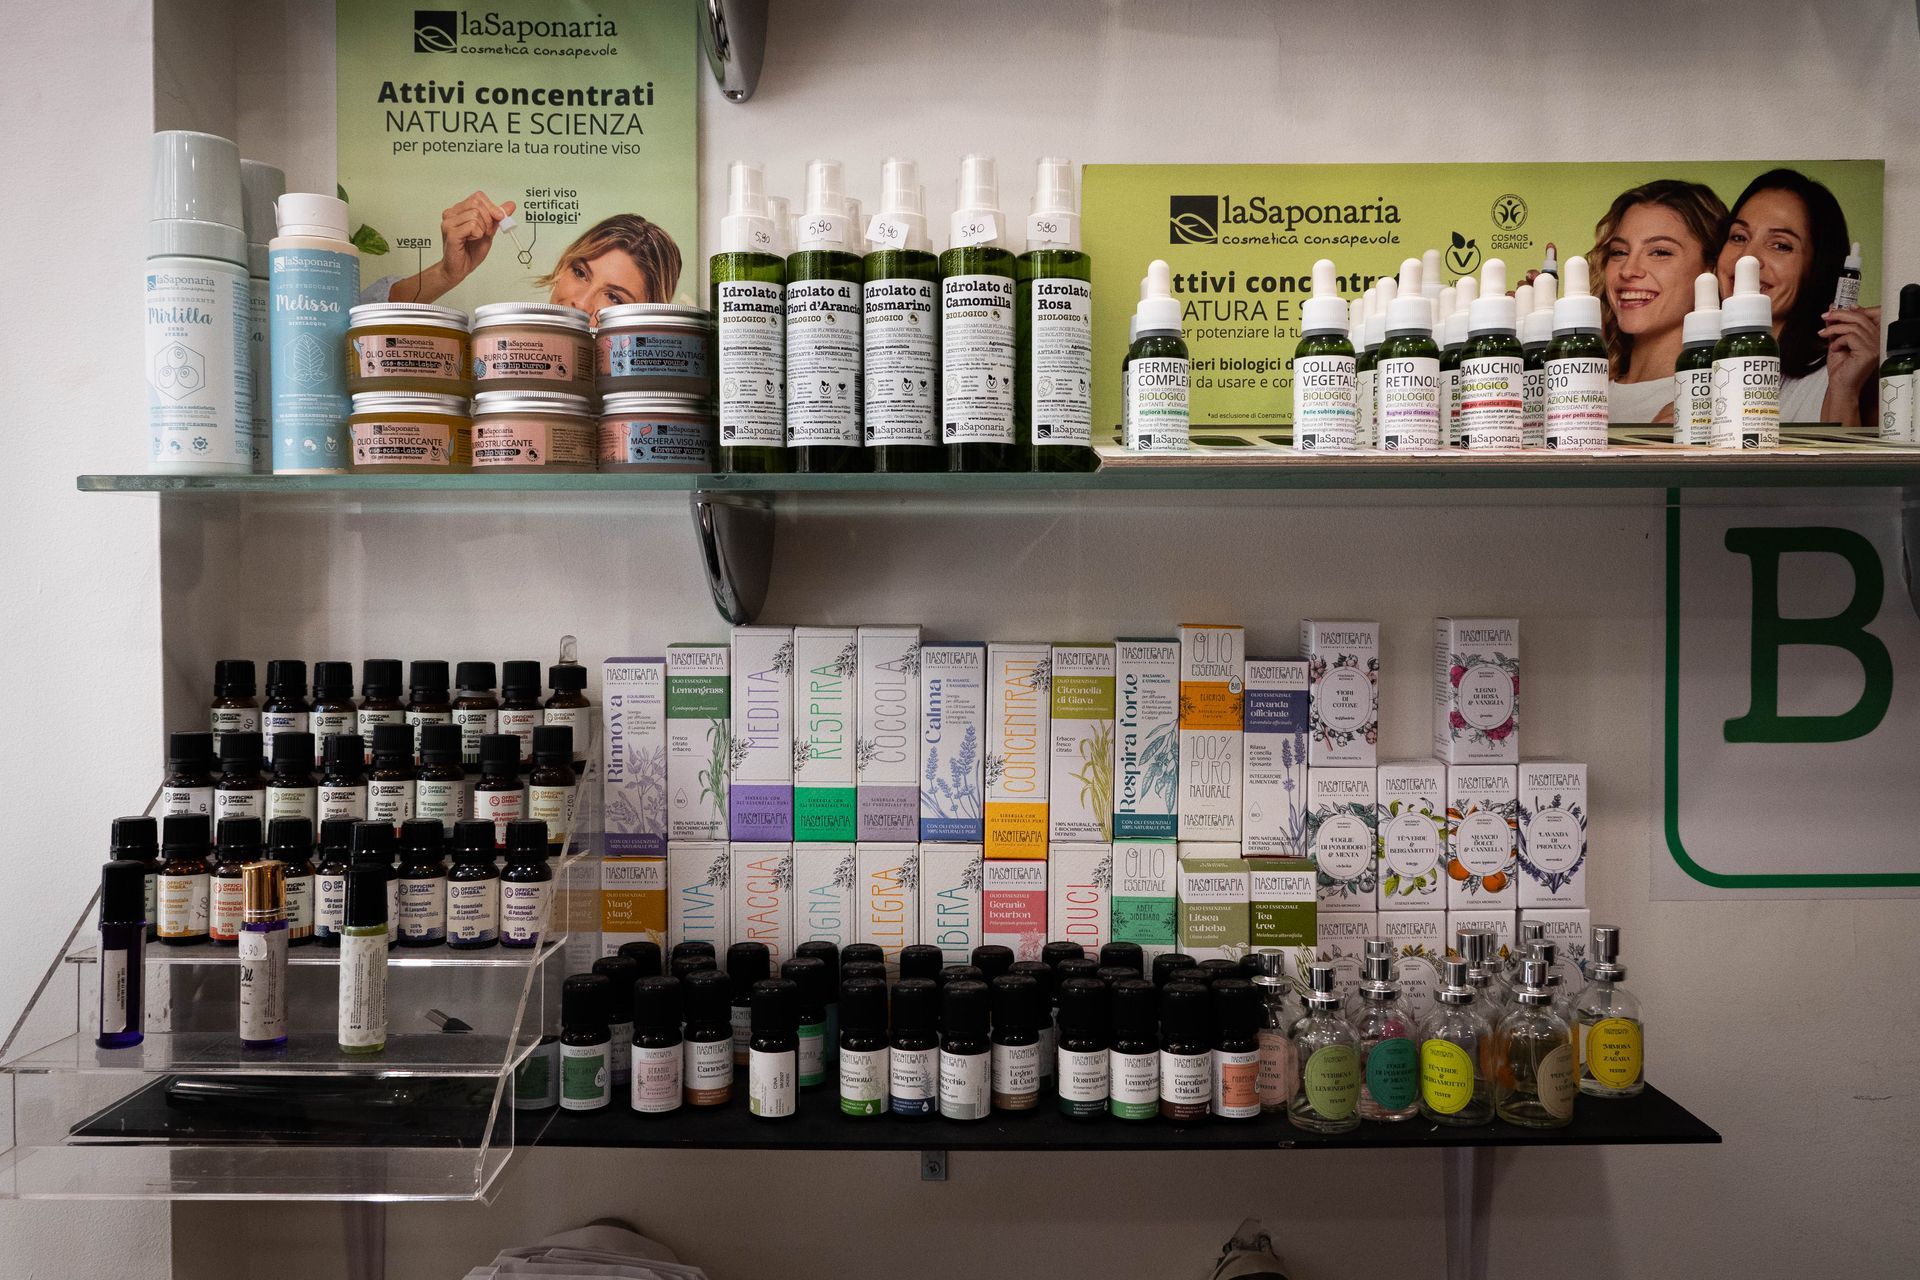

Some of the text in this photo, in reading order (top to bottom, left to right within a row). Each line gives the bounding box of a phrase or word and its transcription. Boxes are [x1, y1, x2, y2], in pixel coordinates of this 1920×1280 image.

[461, 11, 618, 43] laSaponaria
[461, 45, 618, 60] cosmetica consapevole
[378, 81, 654, 106] Attivi concentrati
[386, 111, 644, 135] NATURA E SCIENZA
[393, 140, 641, 155] per potenziare la tua routine viso
[526, 188, 577, 198] sieri viso
[524, 199, 579, 210] certificati
[1222, 195, 1401, 231] laSaponaria
[878, 223, 899, 239] 5,90
[962, 224, 984, 237] 5,90
[1037, 222, 1057, 234] 5,90
[397, 236, 432, 248] vegan
[1222, 231, 1401, 248] cosmetica consapevole
[284, 256, 341, 272] laSaponaria
[157, 275, 215, 289] laSaponaria
[946, 282, 1013, 295] Idrolato di
[723, 286, 774, 299] Idrolato
[788, 285, 850, 299] Idrolato di
[866, 285, 931, 299] Idrolato di
[1038, 285, 1089, 299] Idrolato
[276, 294, 340, 313] Melissa
[788, 302, 812, 316] Fiori
[866, 300, 931, 313] Rosmarino
[946, 296, 1011, 310] Camomilla
[1038, 298, 1072, 310] Rosa
[149, 308, 213, 326] Mirtilla
[946, 310, 988, 320] BIOLOGICO
[1278, 300, 1289, 321] E
[723, 316, 767, 325] BIOLOGICO
[788, 315, 822, 325] BIOLOGICO
[866, 315, 904, 325] BIOLOGICO
[1038, 314, 1081, 323] BIOLOGICO
[1196, 326, 1285, 339] potenziare la
[396, 338, 434, 348] laSaponaria
[507, 341, 543, 349] laSaponaria
[645, 337, 683, 348] laSaponaria
[366, 350, 455, 362] OLIO GEL STRUCCANTE
[484, 353, 562, 362] BURRO STRUCCANTE
[613, 350, 705, 361] MASCHERA VISO ANTIAGE
[660, 360, 687, 368] young
[1220, 358, 1281, 373] biologici
[1386, 362, 1414, 373] FITO
[1547, 362, 1608, 376] COENZIMA
[1196, 377, 1268, 388] da usare e
[1462, 382, 1508, 392] BIOLOGICO
[1547, 375, 1568, 390] Q10
[1140, 392, 1186, 402] BIOLOGICO
[1304, 392, 1351, 401] BIOLOGICO
[1387, 392, 1435, 402] BIOLOGICO
[1547, 394, 1576, 407] AZIONE
[737, 426, 781, 439] laSaponaria
[795, 426, 841, 438] laSaponaria
[874, 425, 923, 439] laSaponaria
[955, 422, 1005, 437] laSaponaria
[357, 437, 443, 448] OLIO GEL STRUCCANTE
[494, 439, 533, 448] STRUCCANTE
[631, 437, 686, 446] MASCHERA VISO
[1460, 630, 1512, 642] NASOTERAPIA
[1724, 526, 1894, 744] B
[1194, 632, 1233, 664] OLIO
[671, 653, 724, 666] NASOTERAPIA
[926, 652, 978, 664] NASOTERAPIA
[607, 668, 659, 681] NASOTERAPIA
[1191, 663, 1234, 677] ESSENZIALE
[1251, 666, 1304, 680] NASOTERAPIA
[672, 686, 724, 696] Lemongrass
[1230, 683, 1241, 691] BIO
[748, 669, 780, 749] MEDITA
[1251, 700, 1289, 709] Lavanda
[810, 664, 843, 760] RESPIRA
[875, 662, 907, 763] COCCOLA
[925, 679, 942, 744] Calma
[1251, 709, 1289, 718] officinale
[1003, 660, 1036, 793] CONCENTRATI
[608, 695, 623, 783] Rinnova
[1119, 674, 1141, 813] Respira forte
[1190, 735, 1232, 760] 100%
[1191, 761, 1231, 785] PURO
[1190, 785, 1231, 799] NATURALE
[1184, 814, 1234, 827] NASOTERAPIA
[1189, 879, 1244, 892] NASOTERAPIA
[1189, 914, 1219, 922] Litsea
[1256, 912, 1272, 920] Tea
[1189, 924, 1226, 932] cubeba
[893, 1074, 922, 1083] Ginepro
[1010, 1069, 1033, 1077] Legno
